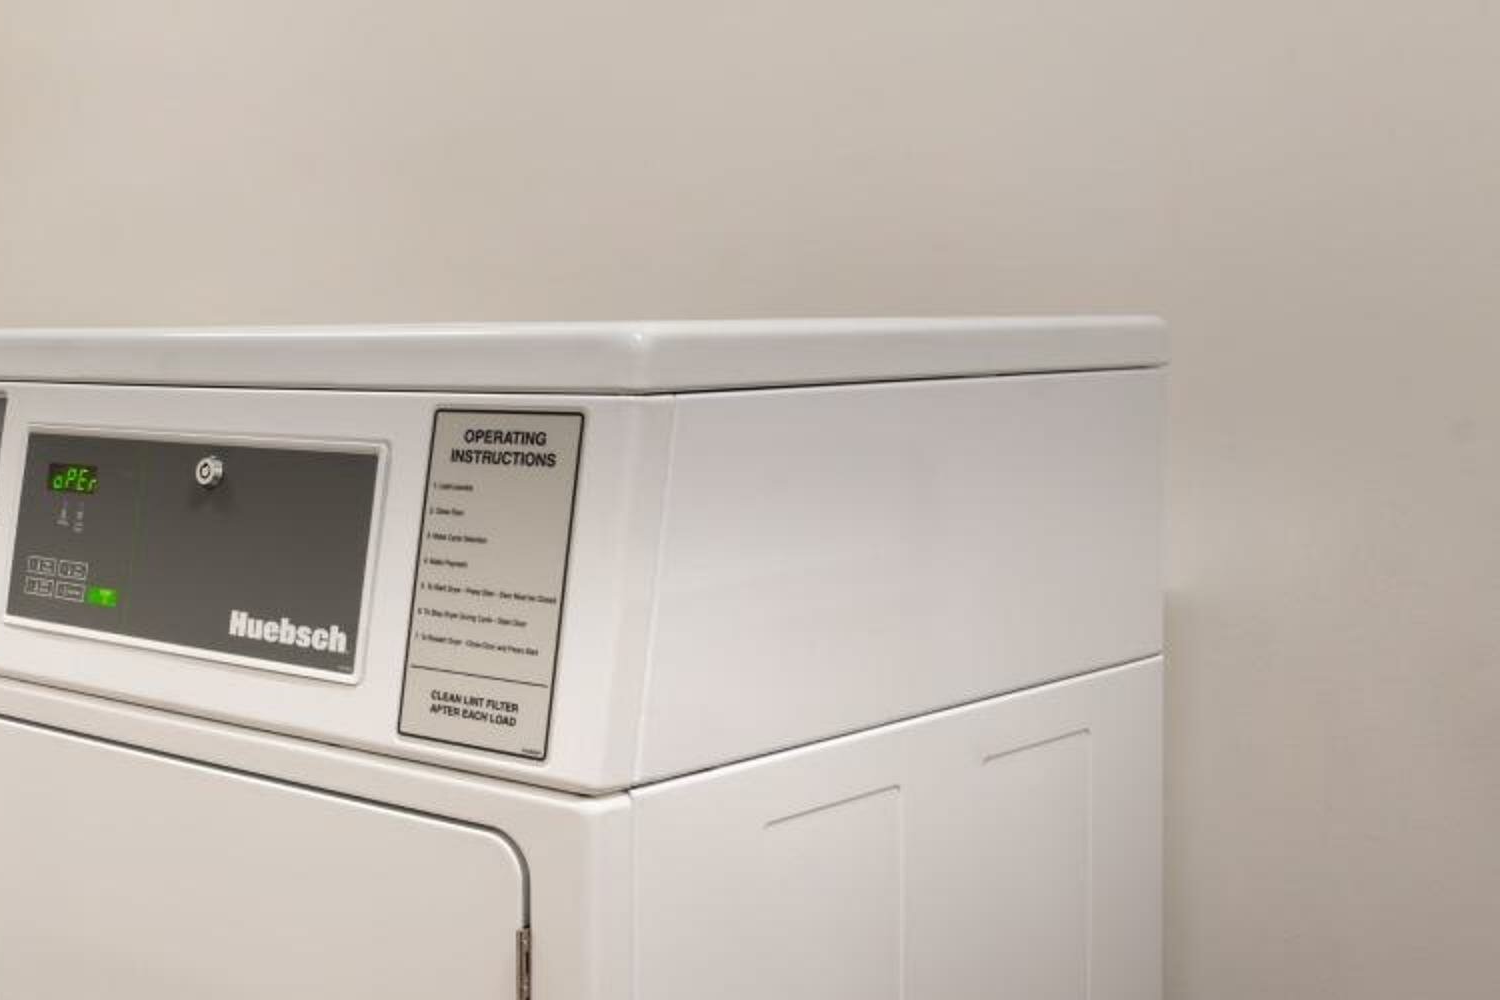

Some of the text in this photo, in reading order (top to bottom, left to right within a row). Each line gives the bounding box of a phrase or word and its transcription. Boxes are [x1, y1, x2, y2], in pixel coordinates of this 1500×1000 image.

[463, 429, 547, 446] OPERATING
[451, 449, 557, 467] INSTRUCTIONS
[228, 609, 347, 653] Huebsch
[431, 689, 519, 713] CLEAN LINT FILTER
[430, 703, 517, 727] AFTER EACH LOAD
